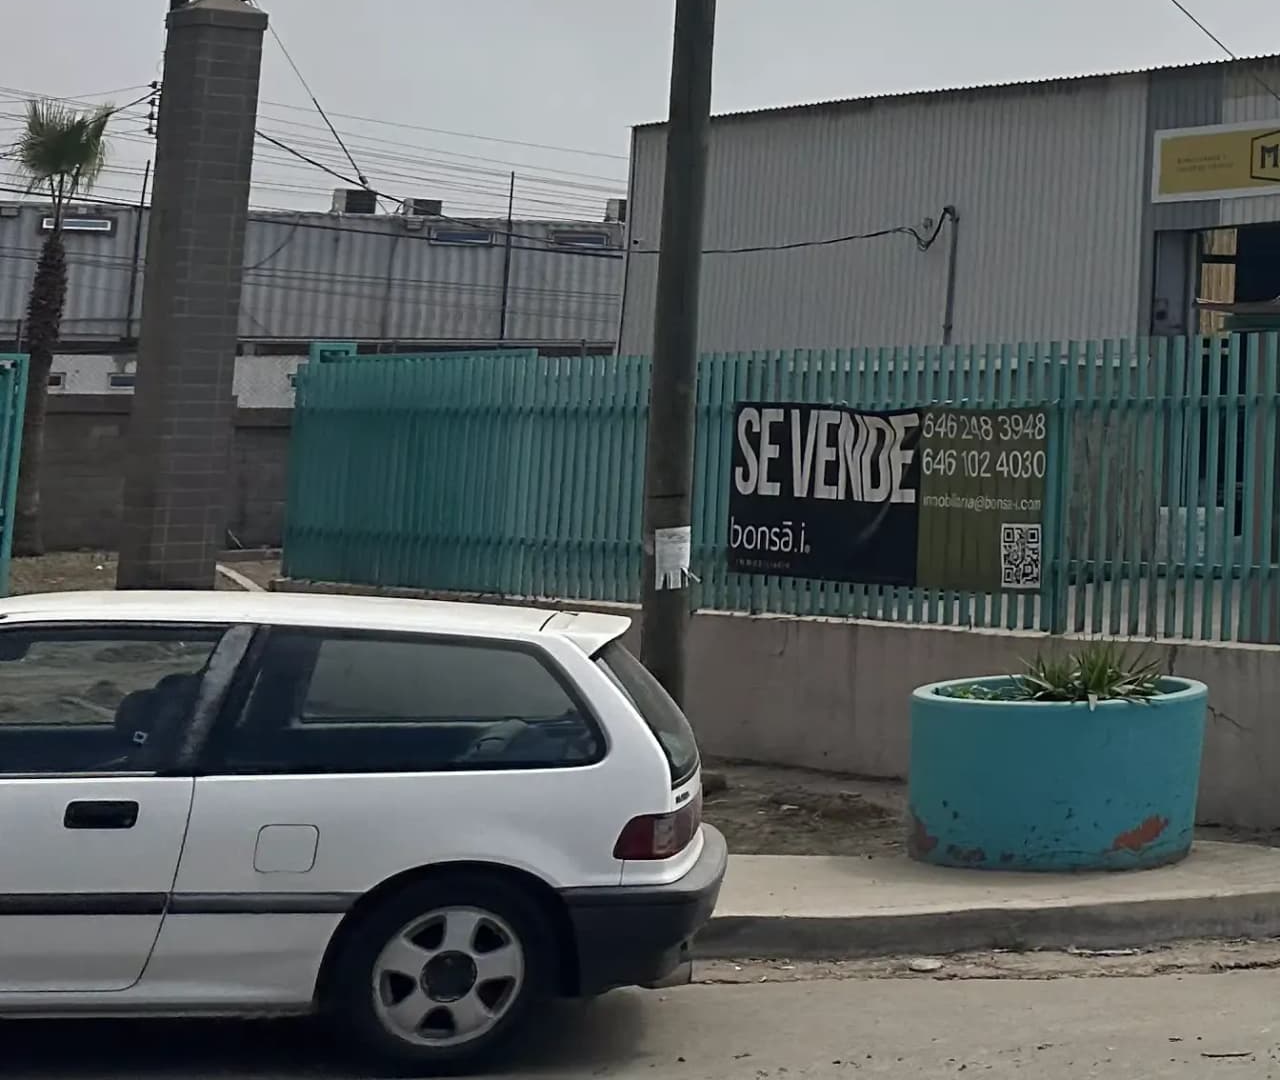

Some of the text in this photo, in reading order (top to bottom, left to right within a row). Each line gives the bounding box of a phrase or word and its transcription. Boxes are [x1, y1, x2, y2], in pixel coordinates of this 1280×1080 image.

[922, 412, 1046, 441] 646 248 3948
[735, 407, 920, 504] SE VENDE
[922, 448, 1046, 478] 646 102 4030
